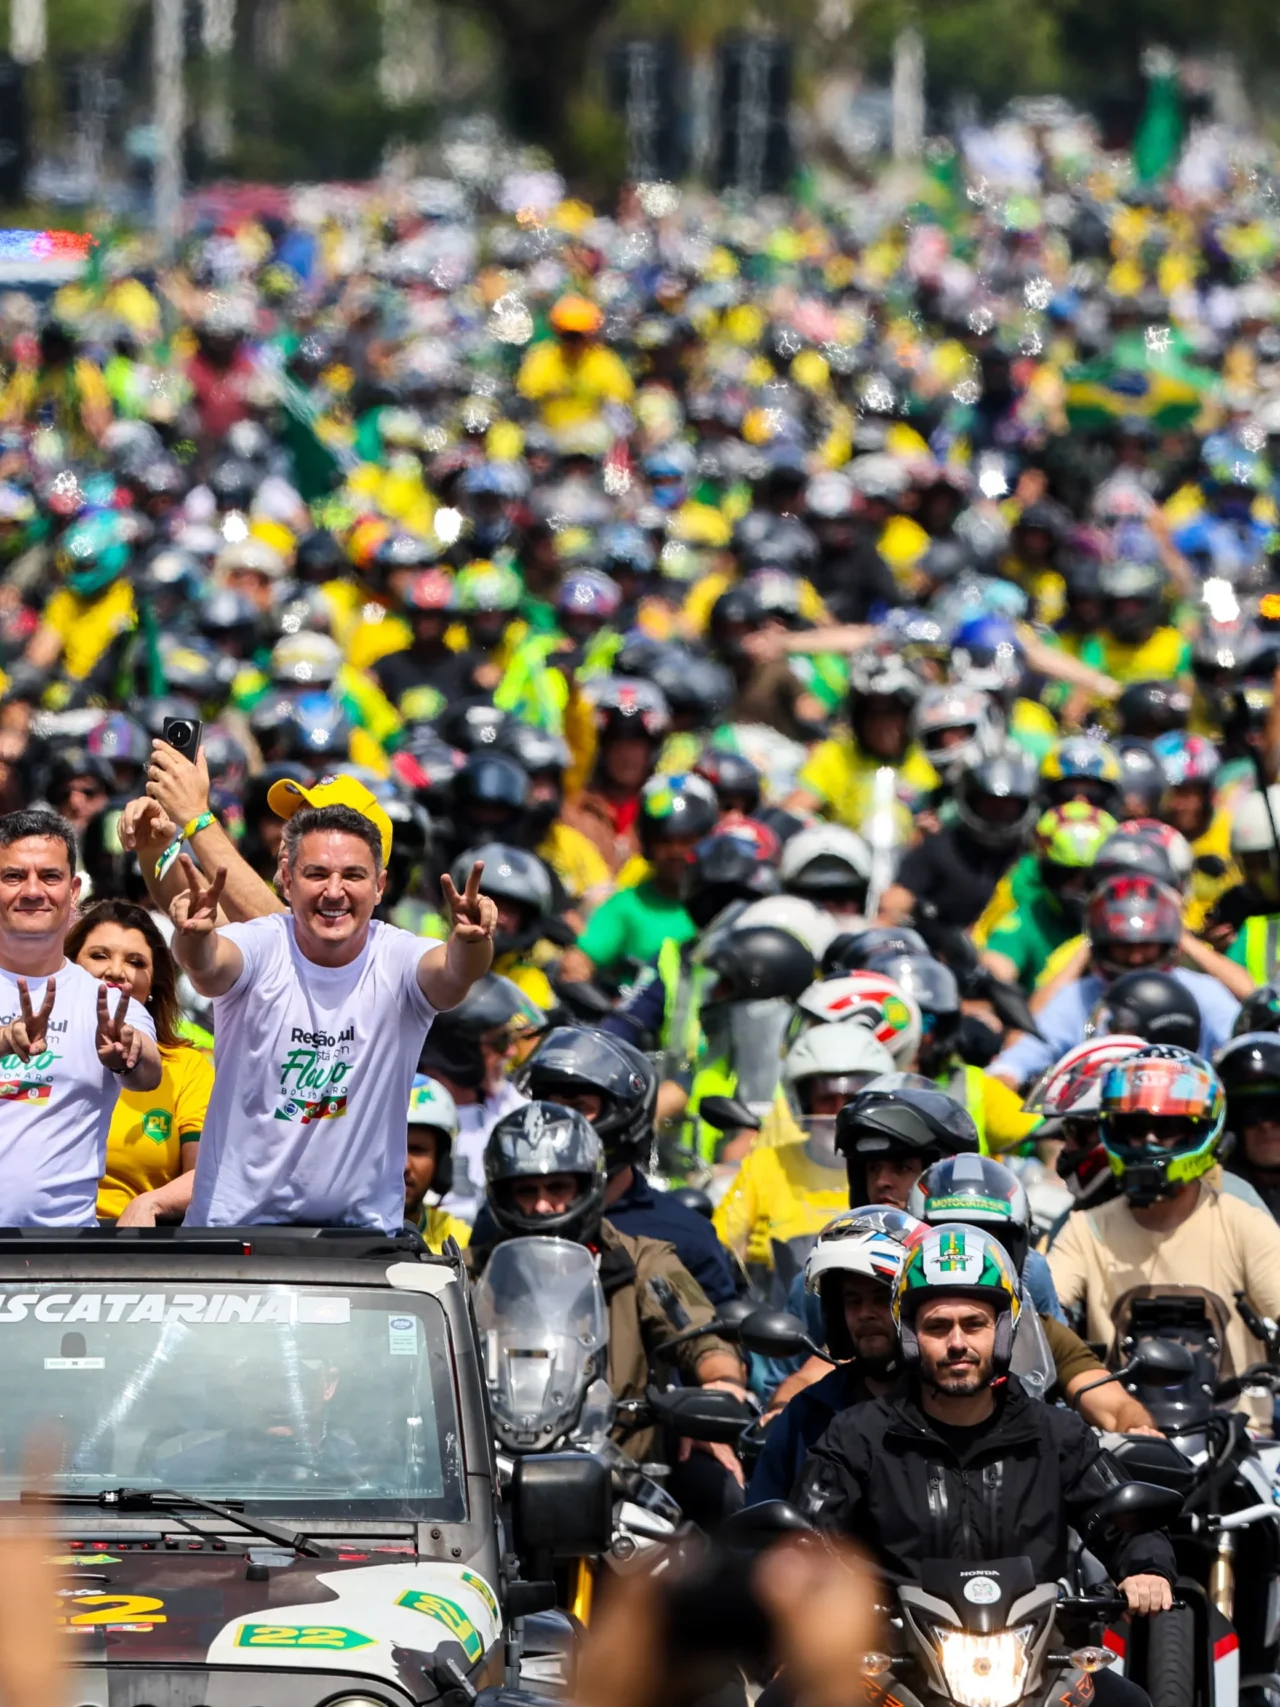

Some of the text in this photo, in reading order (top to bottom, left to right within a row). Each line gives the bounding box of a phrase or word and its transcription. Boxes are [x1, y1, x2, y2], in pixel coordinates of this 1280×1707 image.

[148, 1115, 168, 1131] PL
[959, 1569, 1000, 1577] HONDA
[413, 1594, 474, 1641] 22
[249, 1626, 348, 1647] 22
